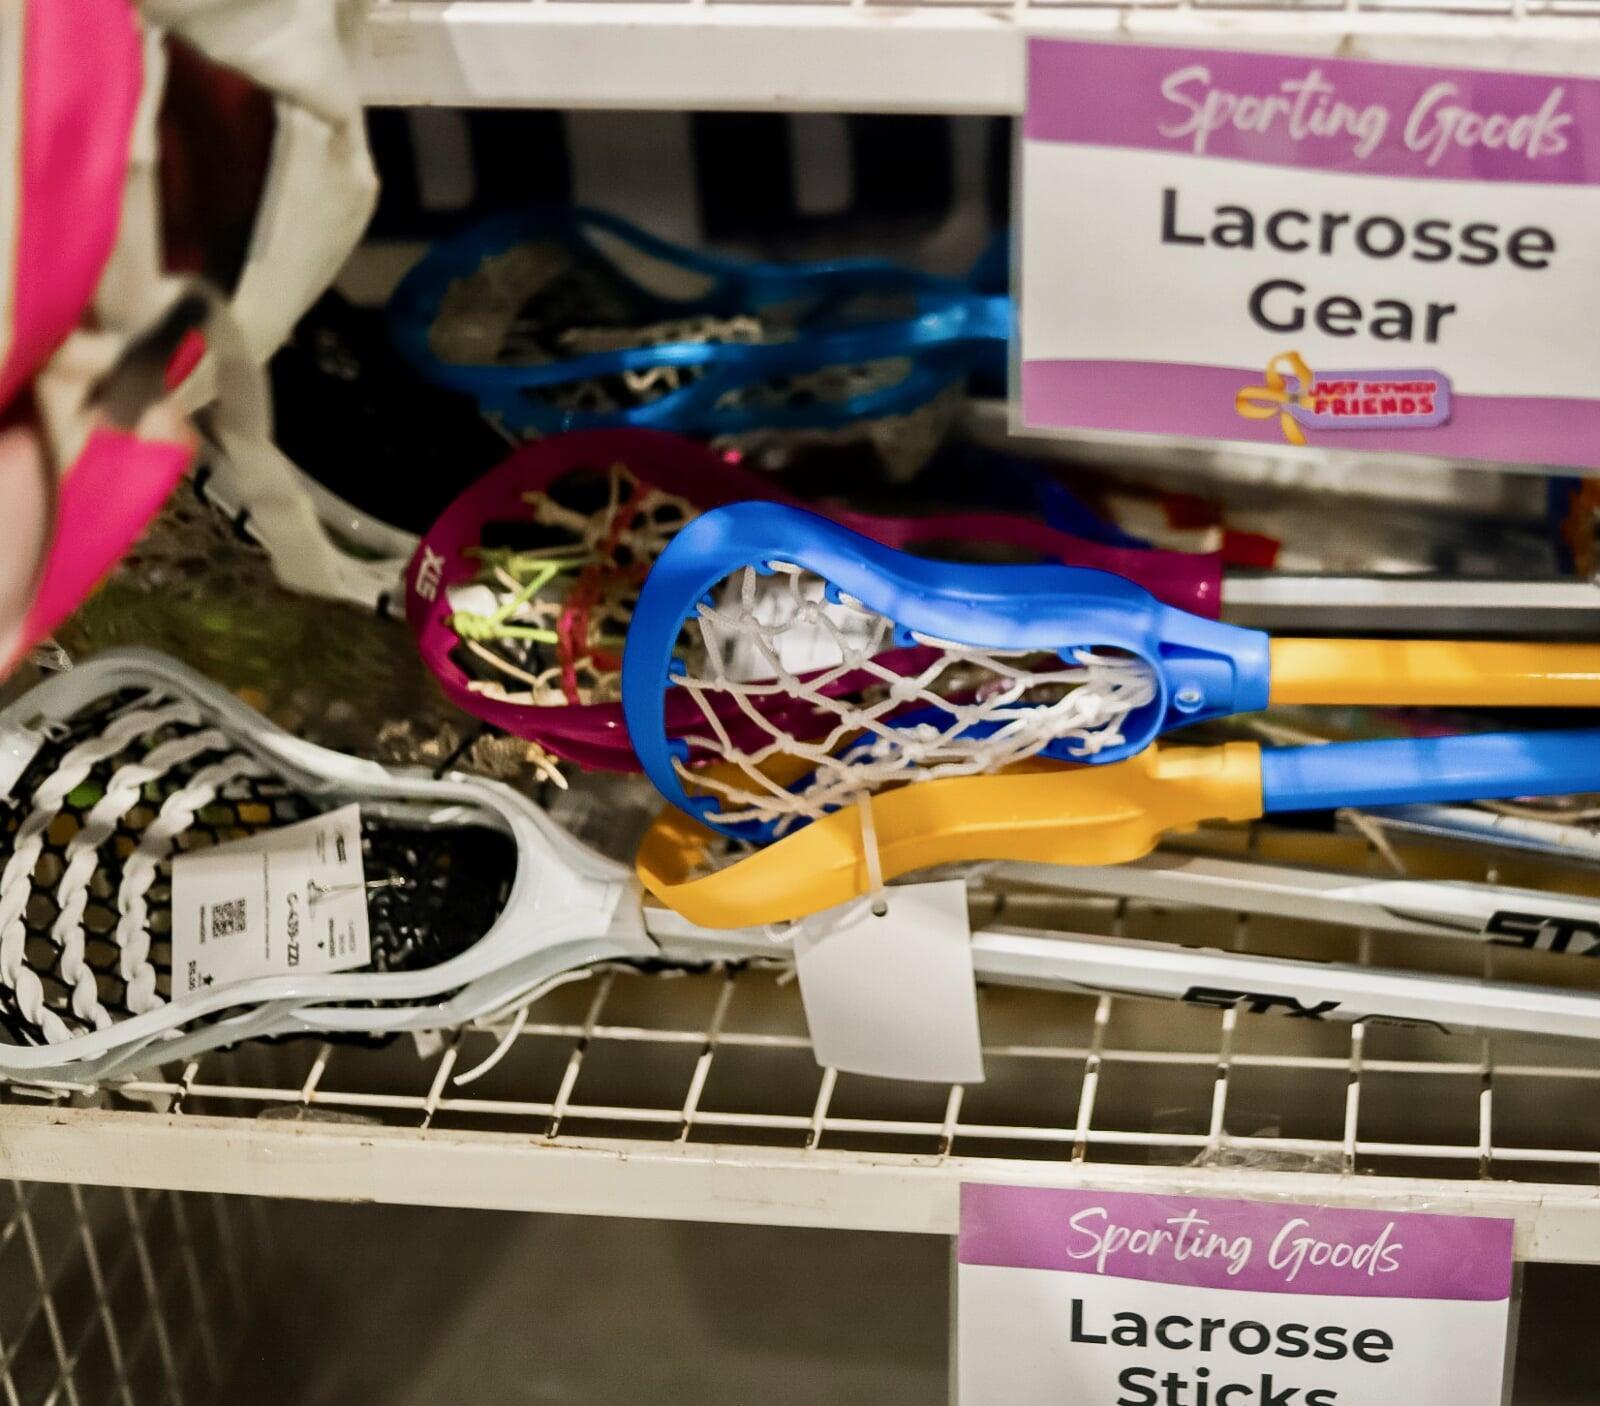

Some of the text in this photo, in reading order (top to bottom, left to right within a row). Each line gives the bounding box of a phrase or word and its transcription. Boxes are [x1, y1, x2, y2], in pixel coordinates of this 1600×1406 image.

[1157, 64, 1573, 166] Sporting Goods
[1161, 187, 1557, 270] Lacrosse
[1247, 278, 1456, 344] Gear
[1309, 381, 1359, 396] JUST
[1313, 397, 1435, 416] FRIENDS
[416, 543, 446, 603] STX
[1485, 910, 1600, 958] ST
[1066, 1206, 1405, 1282] Sporting Goods
[1069, 1298, 1394, 1364] Lacrosse
[1117, 1366, 1339, 1406] Sticks
